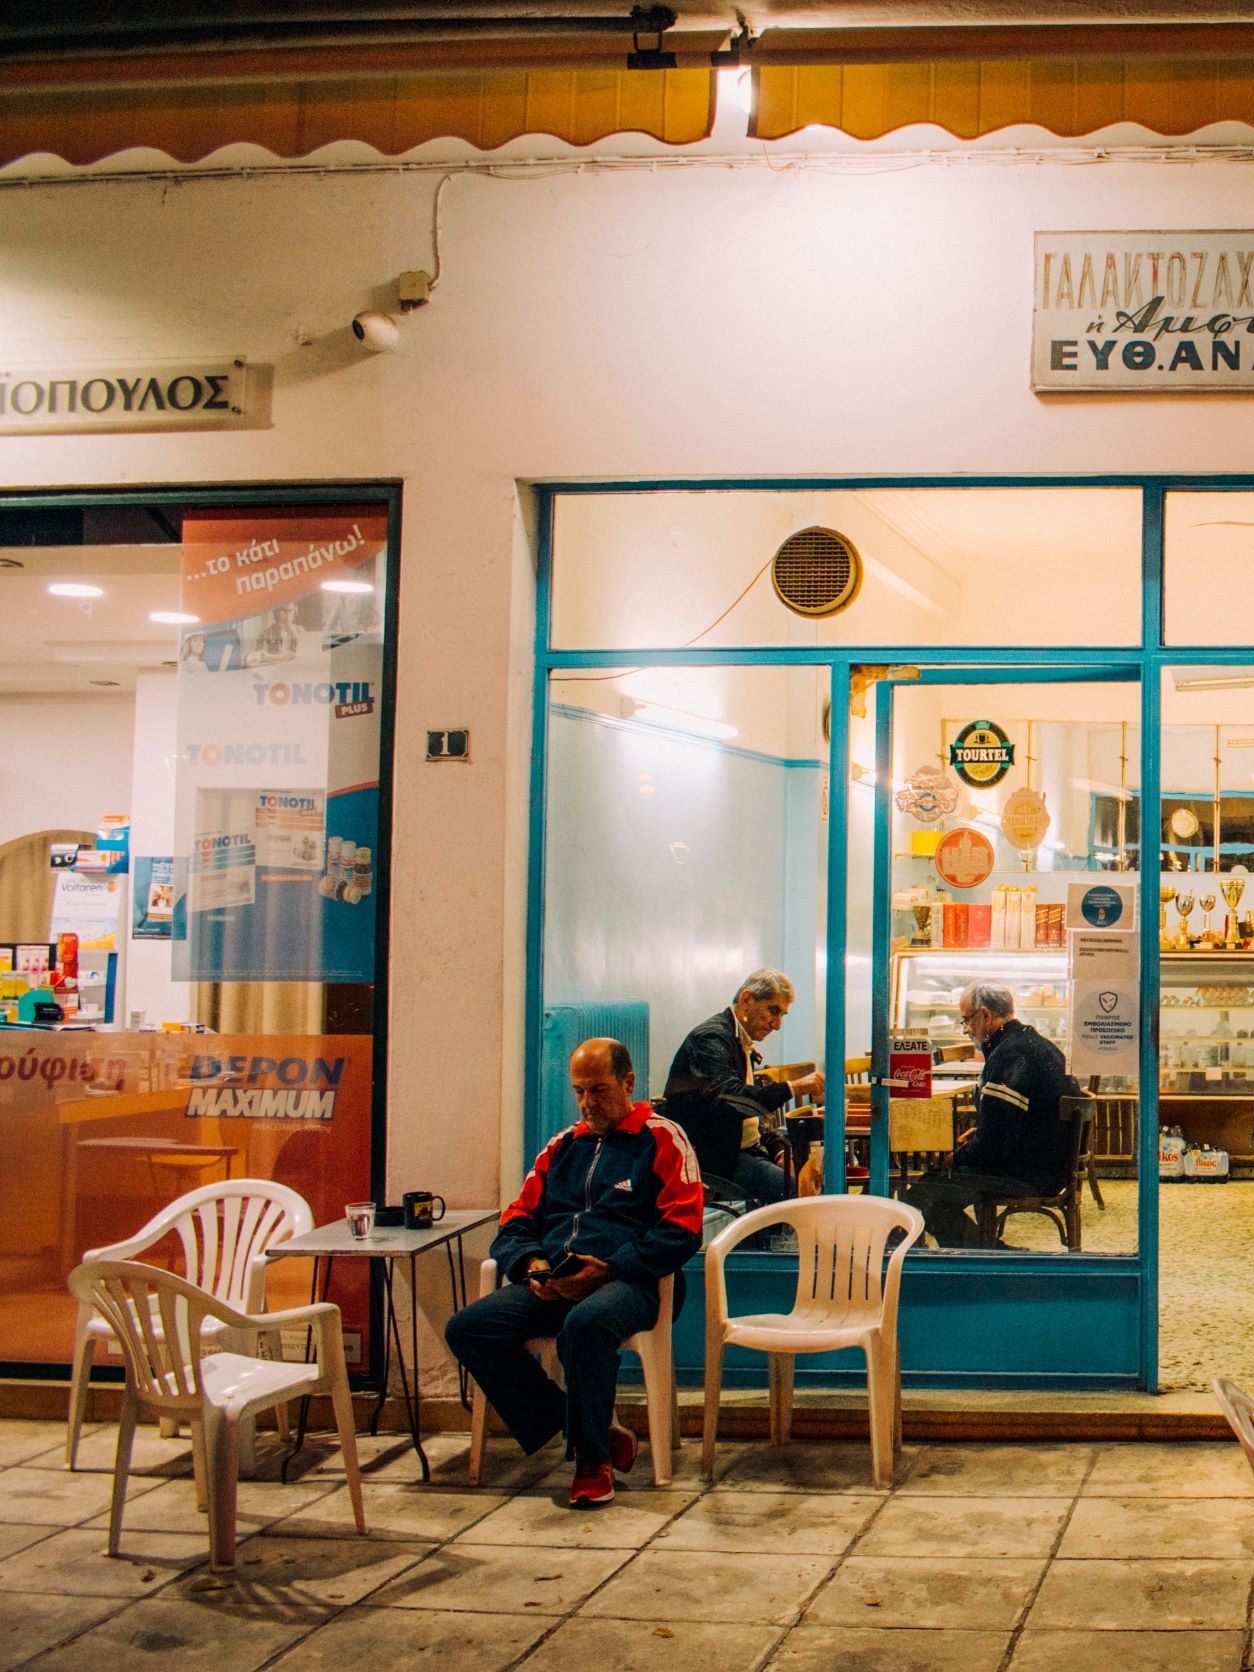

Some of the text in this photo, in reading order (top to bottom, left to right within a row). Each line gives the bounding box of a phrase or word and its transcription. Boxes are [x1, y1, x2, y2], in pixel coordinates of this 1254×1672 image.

[235, 538, 281, 568] κάτι
[235, 523, 366, 595] παραπάνω!
[254, 682, 375, 705] TONOTIL
[341, 702, 368, 716] PLUS
[186, 743, 308, 766] TONOTIL
[955, 748, 1010, 762] TOURTEL
[259, 795, 316, 810] TONOTIL
[194, 833, 252, 851] TONOTIL
[61, 880, 103, 893] Voltaren
[894, 1041, 928, 1051] ΕΛΞΑΤΕ
[191, 1055, 345, 1086] DEPON
[185, 1088, 336, 1119] MAXIMUM
